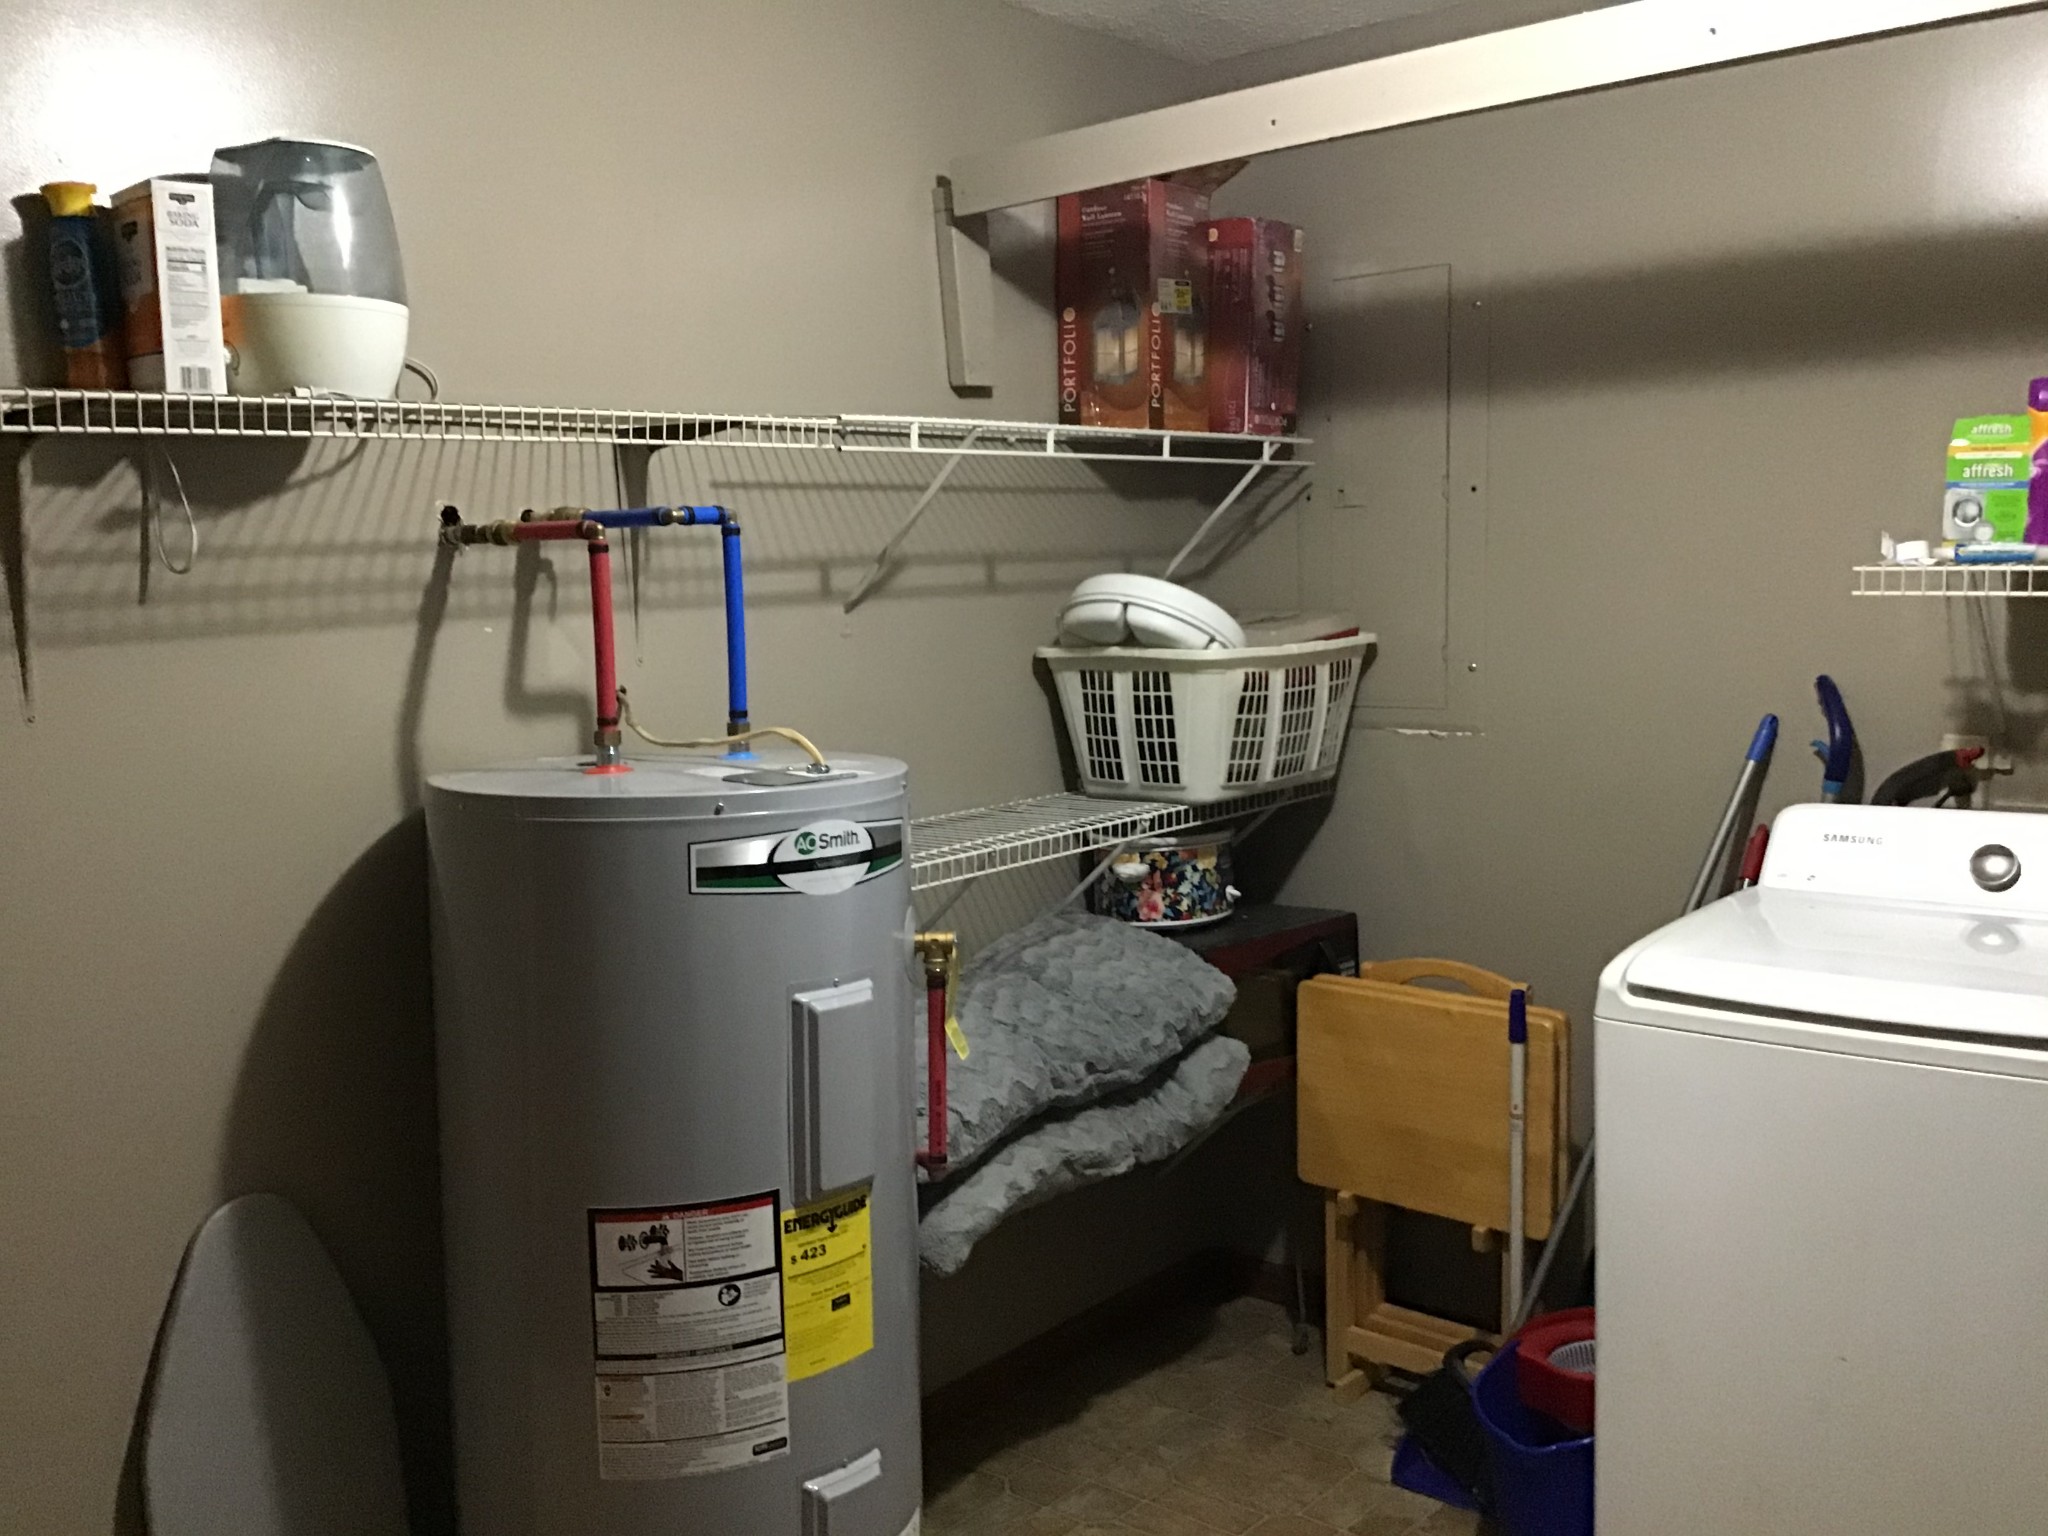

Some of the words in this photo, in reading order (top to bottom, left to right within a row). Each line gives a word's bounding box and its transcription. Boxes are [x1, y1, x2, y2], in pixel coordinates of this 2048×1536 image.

[170, 218, 200, 228] SODA
[1063, 307, 1077, 413] PORTFOLIO
[1151, 302, 1162, 408] PORTFOLIO
[1971, 423, 2012, 435] affresh
[1963, 463, 2013, 478] affresh
[795, 833, 817, 853] AO
[819, 830, 859, 850] Smith
[1823, 833, 1884, 845] SAMSUNG
[673, 1208, 709, 1221] DANGER
